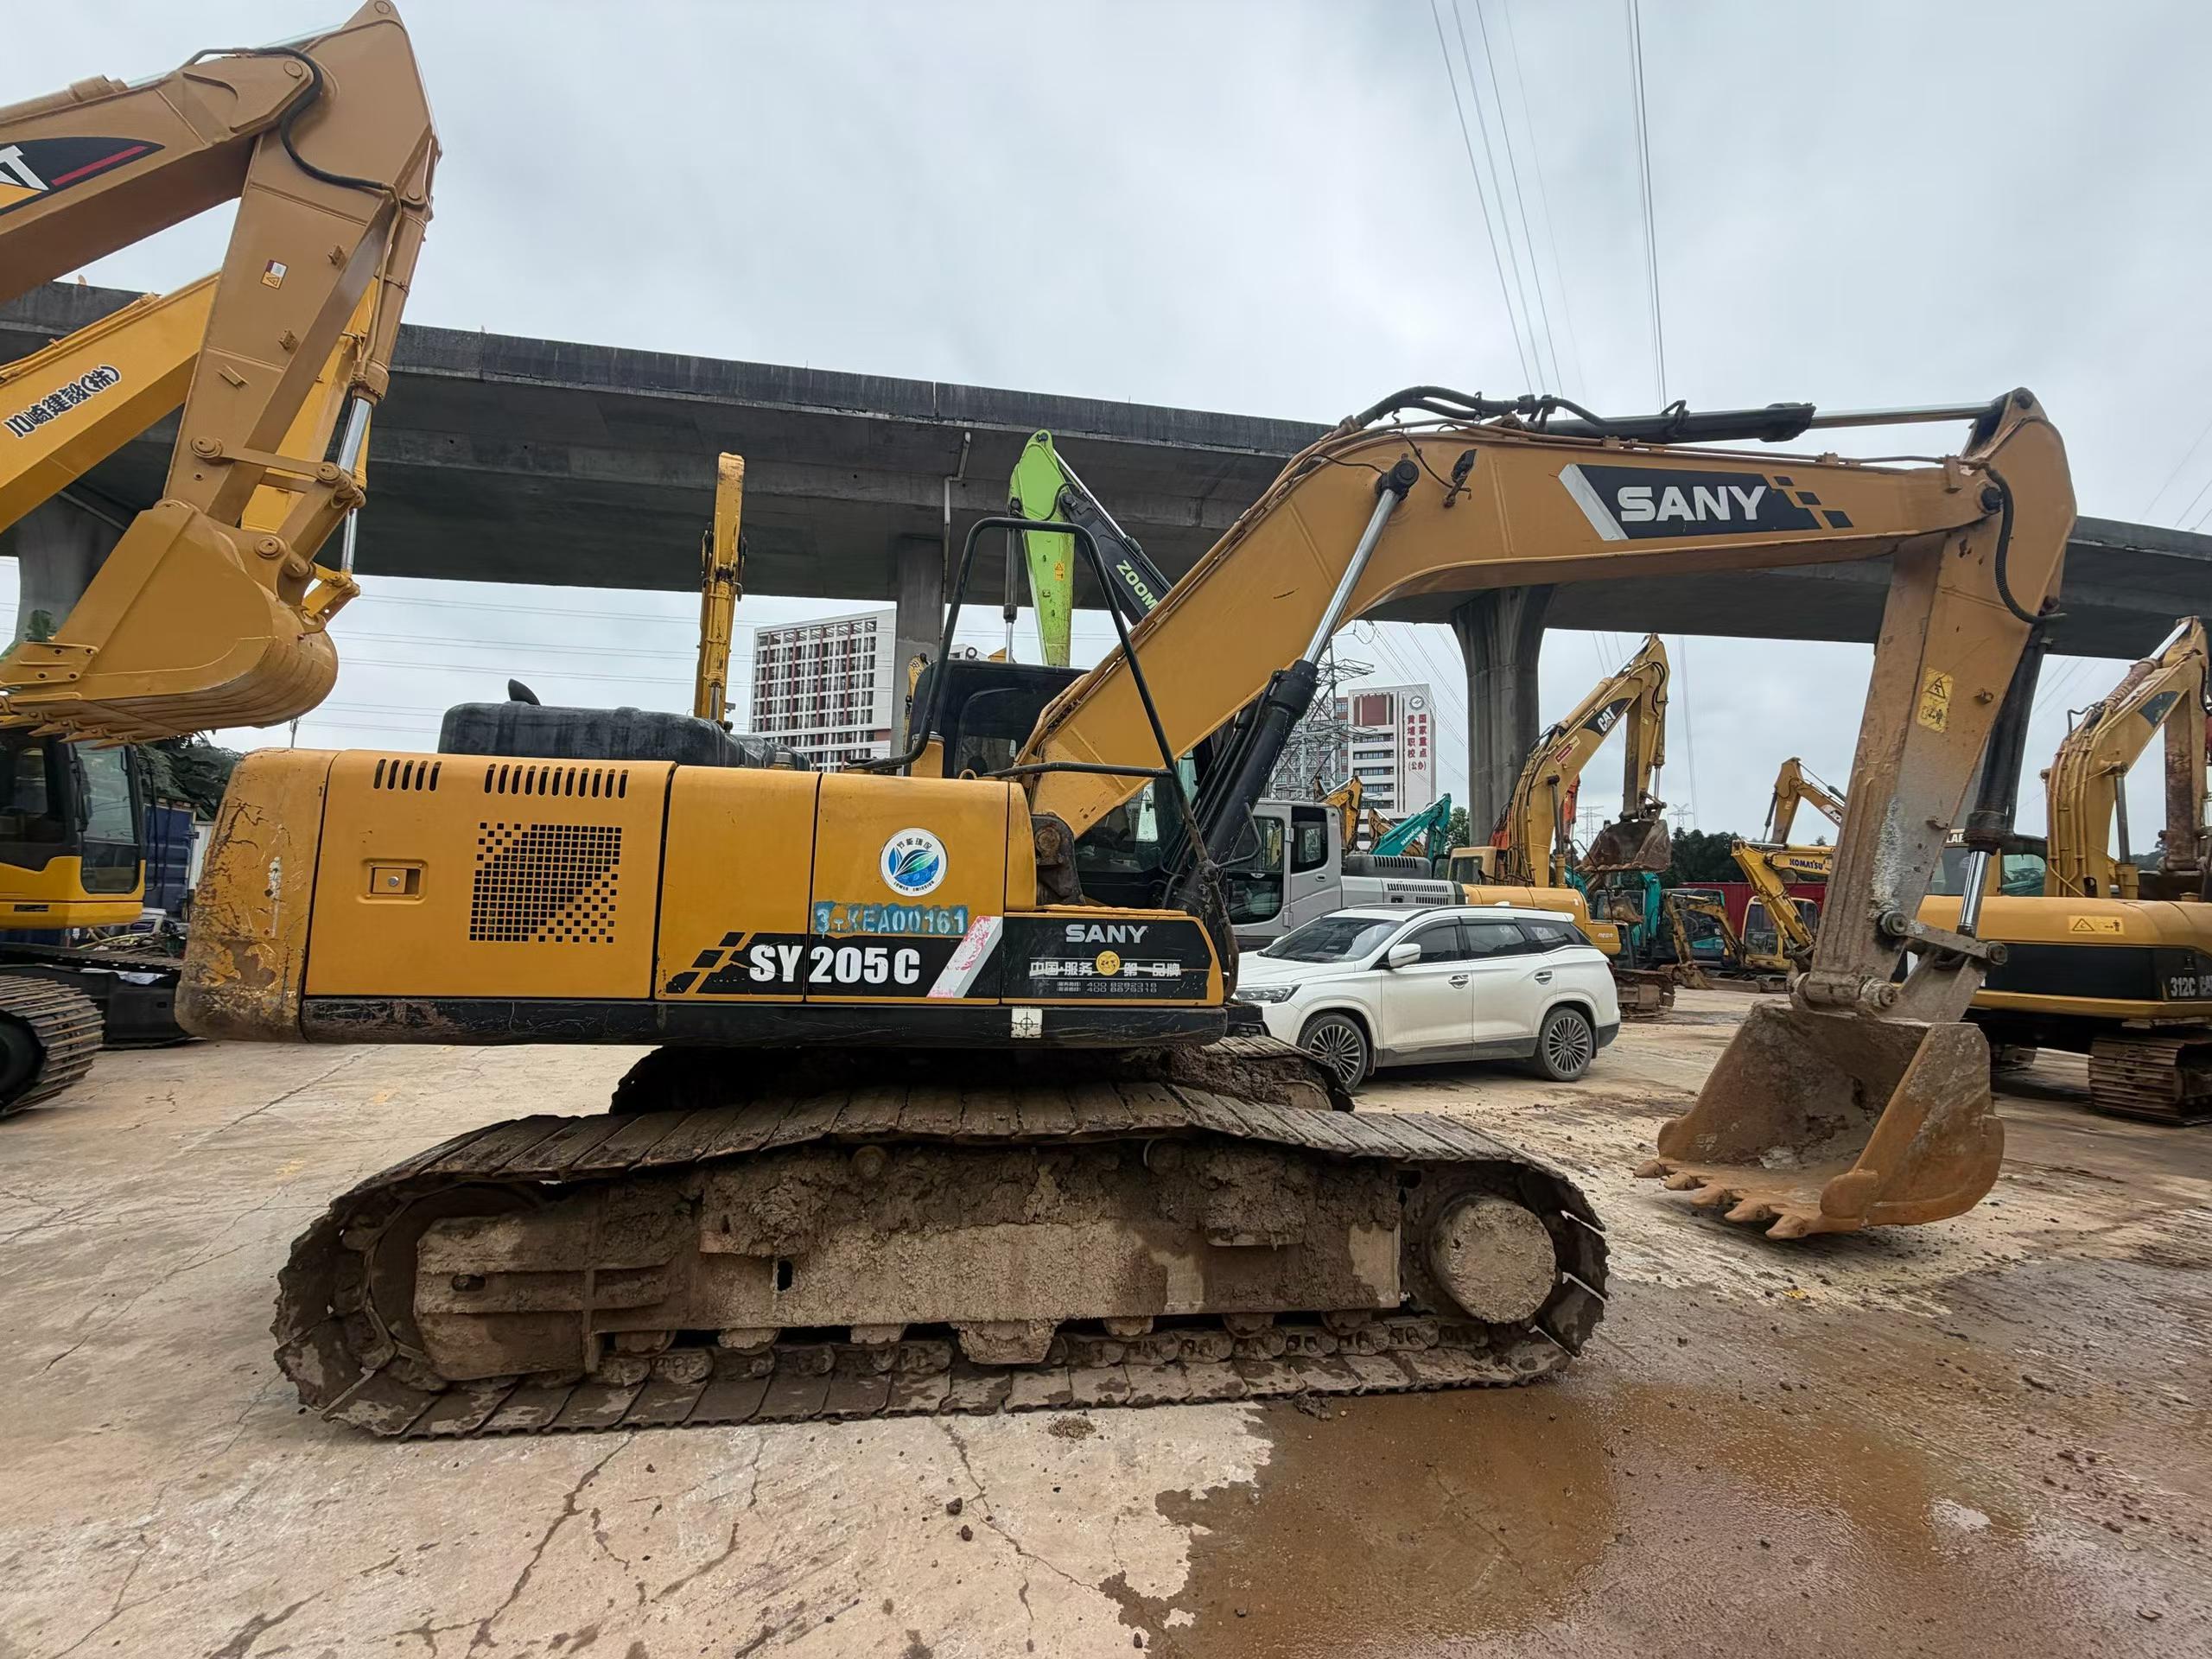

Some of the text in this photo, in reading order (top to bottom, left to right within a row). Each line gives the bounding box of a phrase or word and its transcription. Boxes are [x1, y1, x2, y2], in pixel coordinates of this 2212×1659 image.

[1617, 486, 1767, 522] SANY
[1597, 705, 1617, 732] CAT
[1789, 858, 1824, 870] KOMATSU
[1065, 924, 1148, 944] SANY
[2170, 976, 2196, 997] 312C
